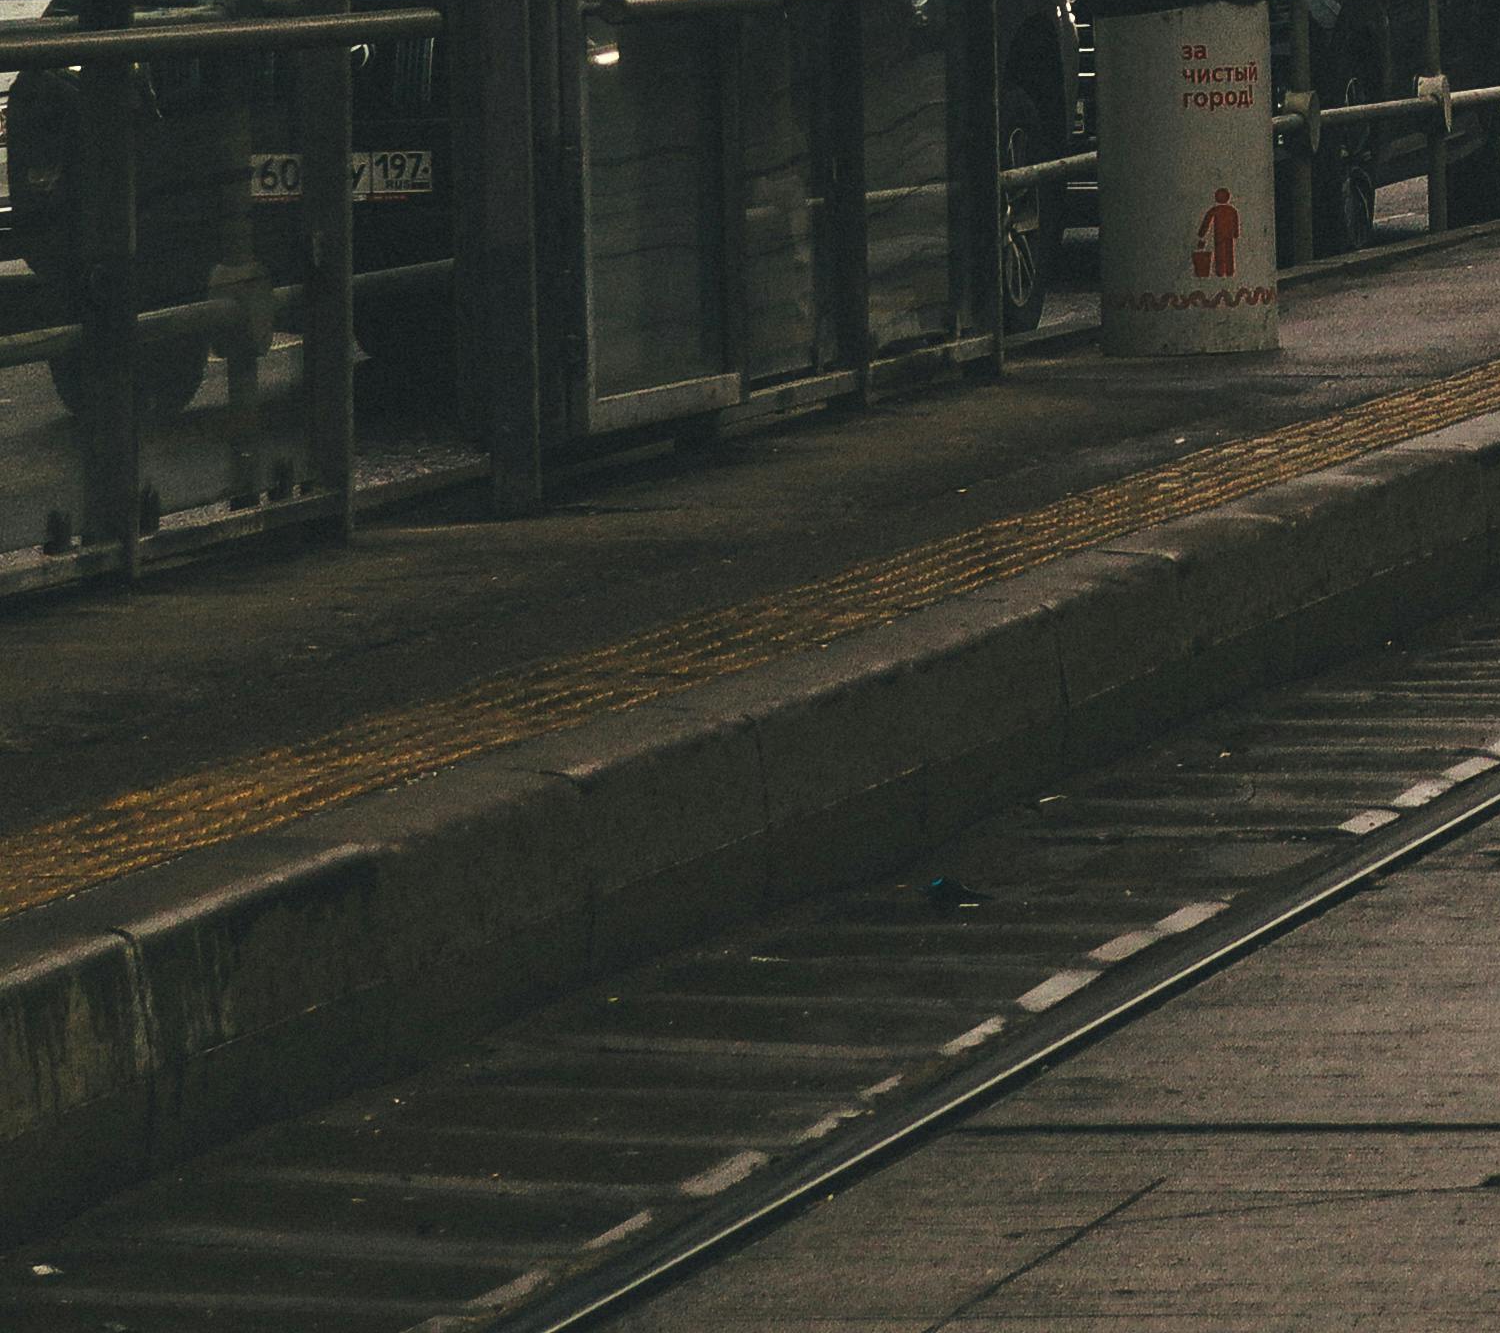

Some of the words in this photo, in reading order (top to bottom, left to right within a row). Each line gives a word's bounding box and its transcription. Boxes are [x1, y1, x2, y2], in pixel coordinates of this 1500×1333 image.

[1181, 44, 1208, 60] за
[1182, 61, 1258, 84] чистый
[1182, 85, 1254, 111] город!
[374, 152, 425, 180] 197
